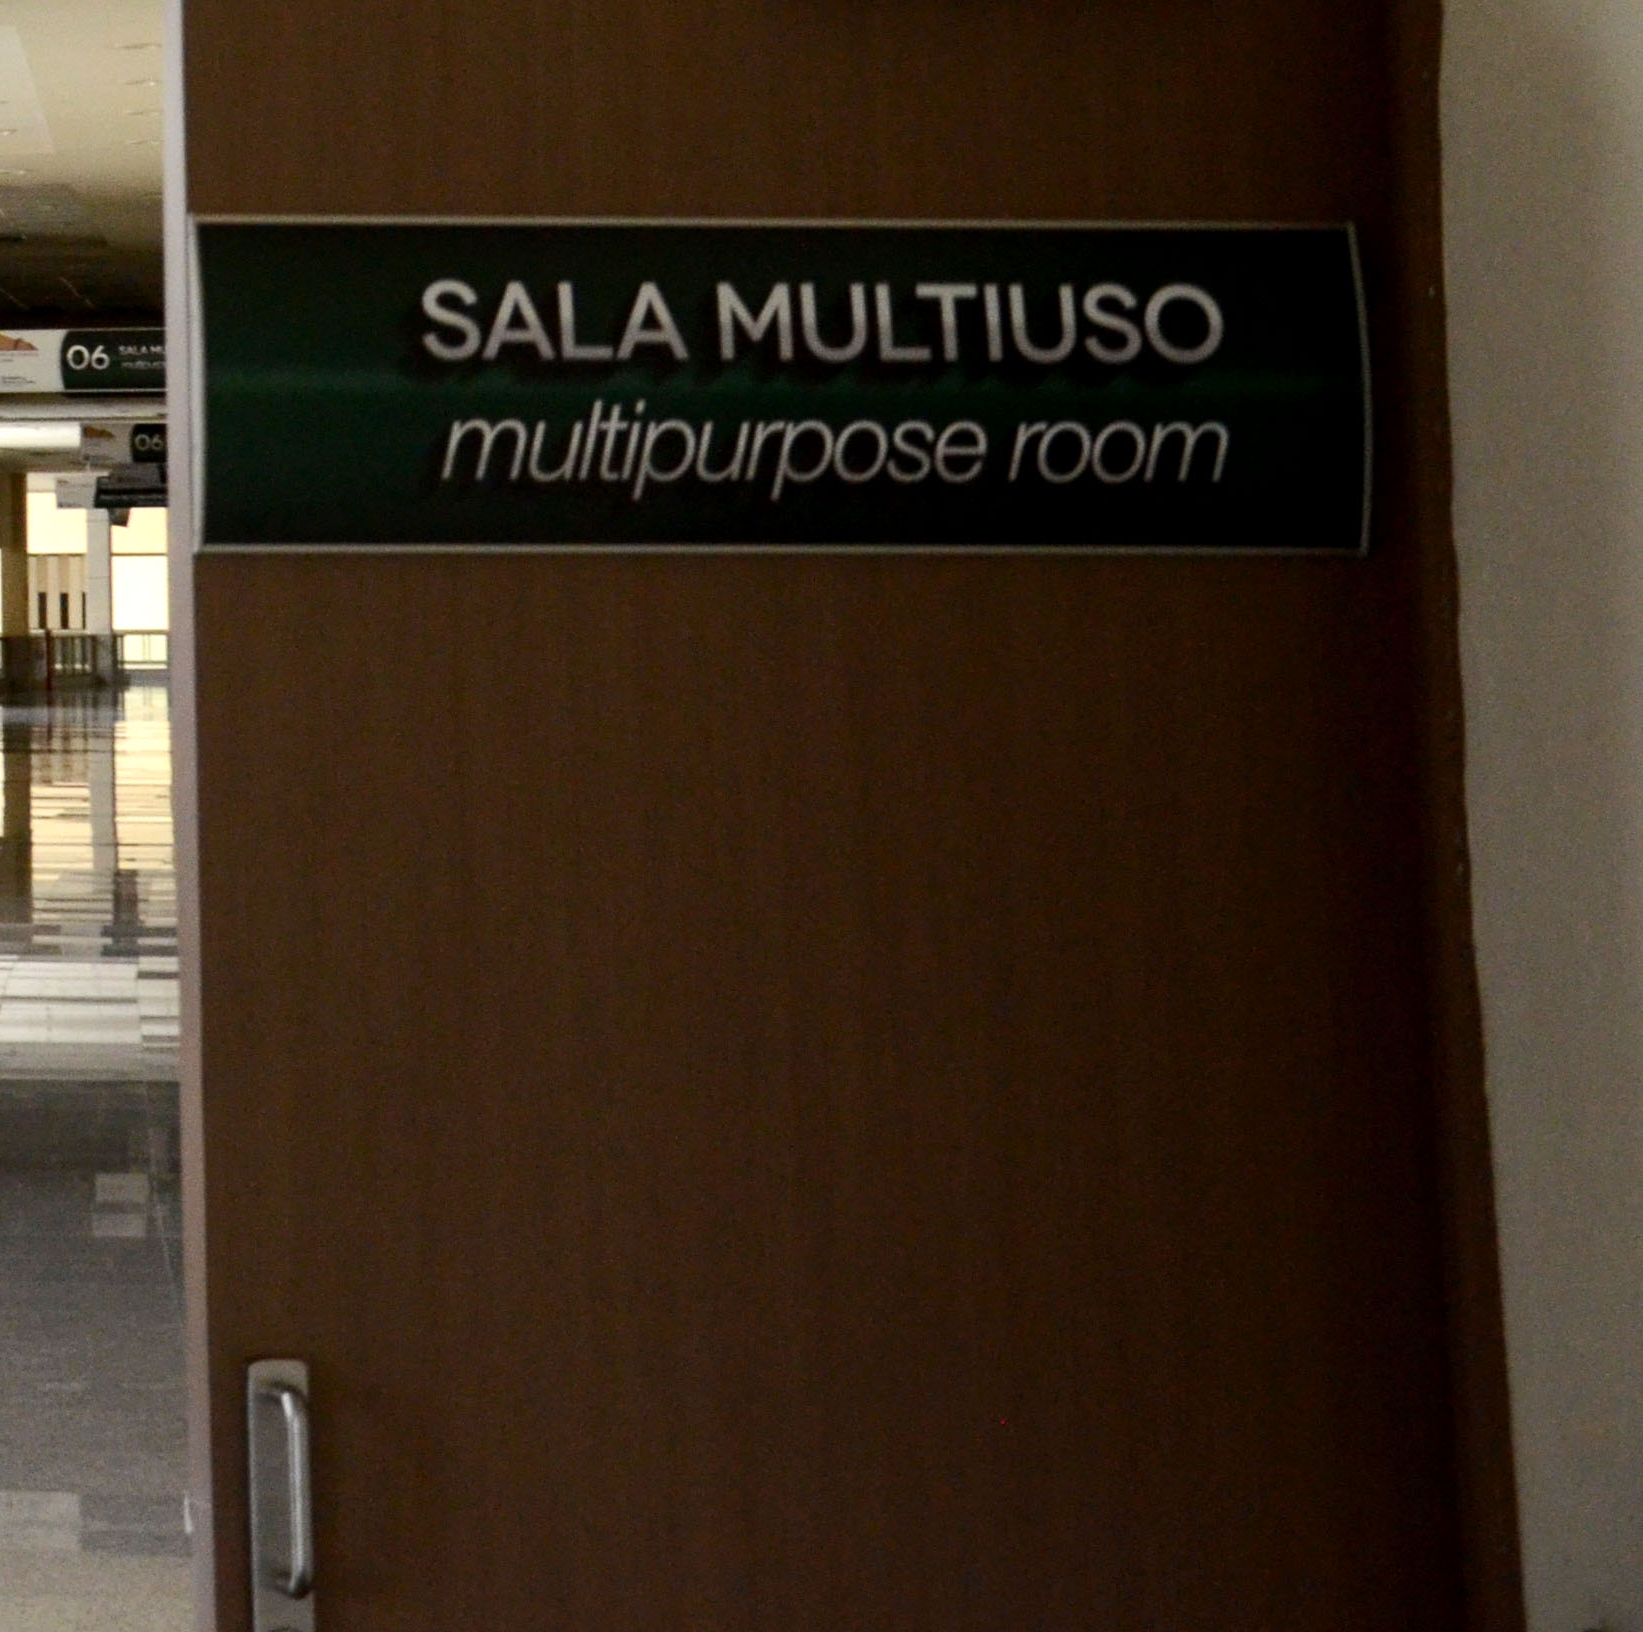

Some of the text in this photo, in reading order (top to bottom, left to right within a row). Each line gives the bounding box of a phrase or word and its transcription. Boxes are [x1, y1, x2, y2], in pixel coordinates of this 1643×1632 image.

[421, 279, 1224, 363] SALA MULTIUSO
[67, 344, 110, 370] 06
[135, 433, 165, 451] 06
[440, 400, 1230, 502] multipurpose room
